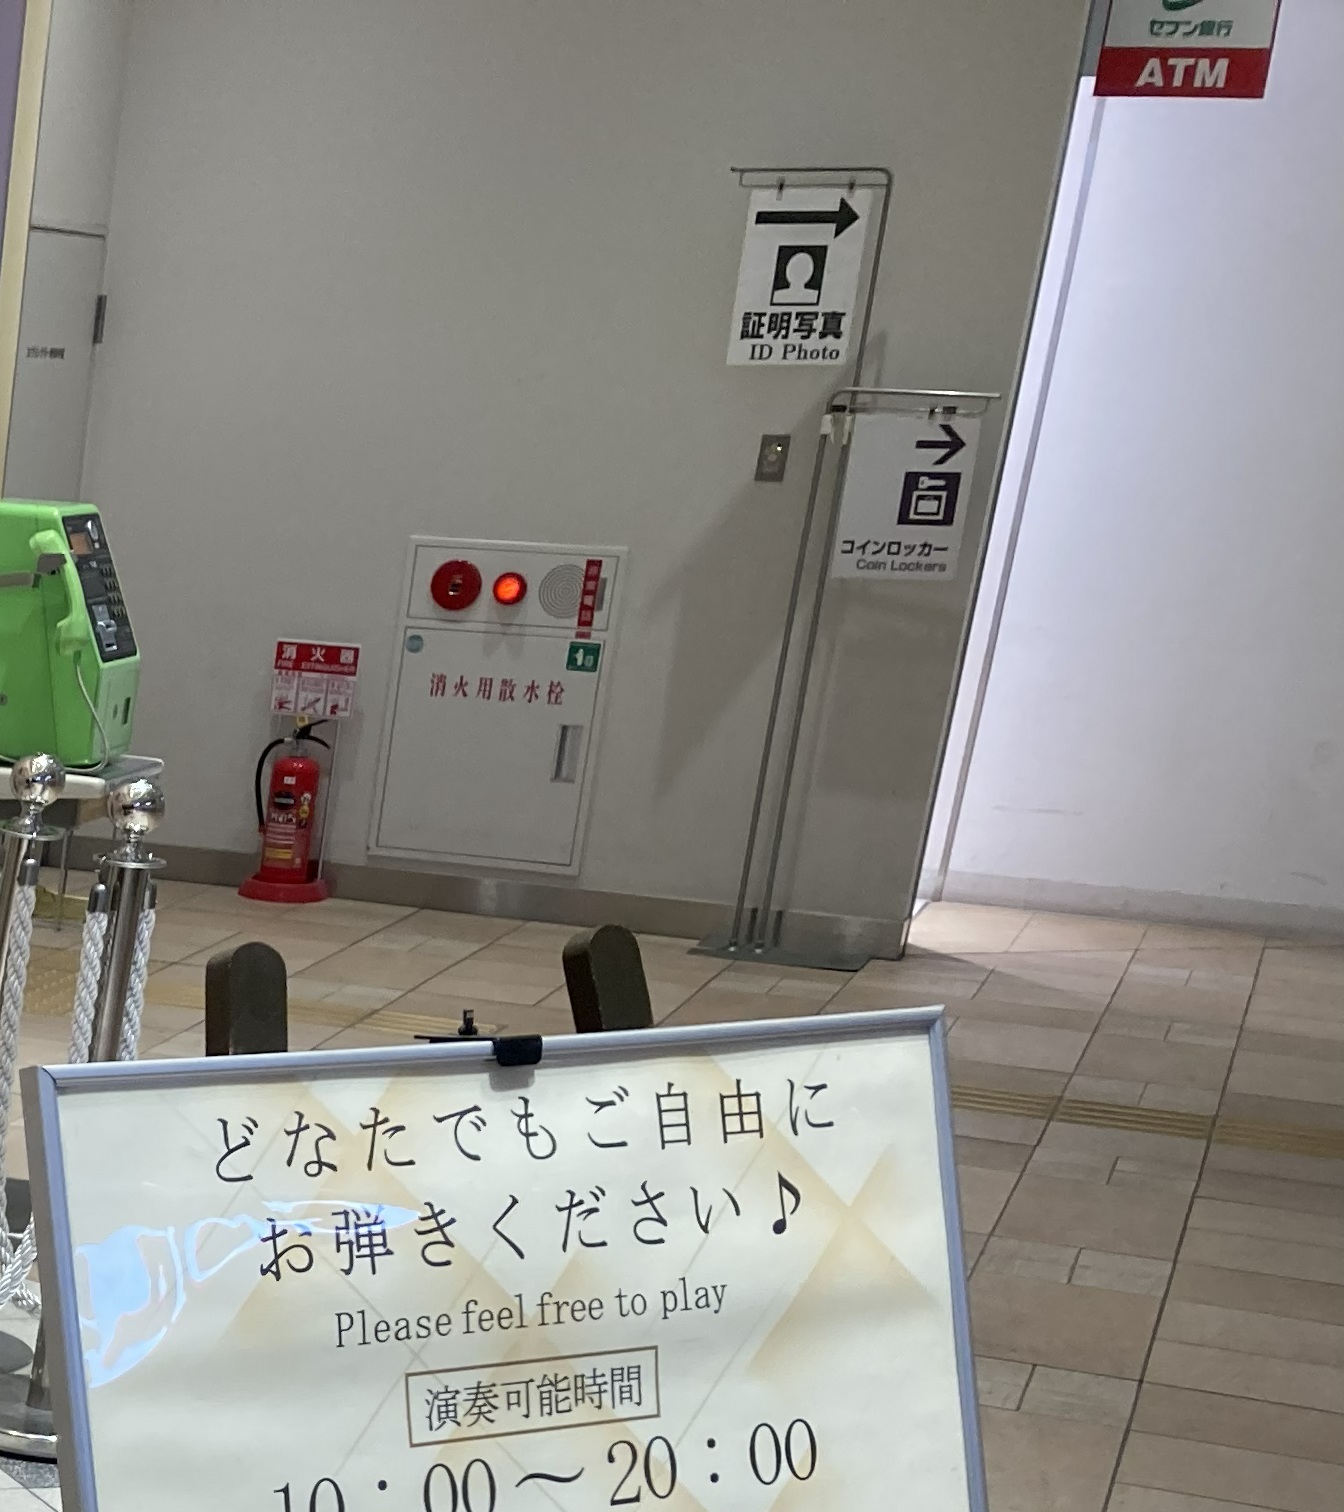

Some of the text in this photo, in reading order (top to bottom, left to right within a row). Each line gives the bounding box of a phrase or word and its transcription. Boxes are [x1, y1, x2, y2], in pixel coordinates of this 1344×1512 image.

[1135, 57, 1230, 88] ATM
[740, 311, 846, 340] 証明写真
[749, 343, 840, 360] ID Photo
[841, 539, 949, 557] コインロッカー
[856, 559, 947, 572] Coin Lockers
[429, 672, 565, 706] 消火用散水栓
[214, 1077, 836, 1183] どなたでもご自由に
[335, 1278, 729, 1348] Please feel free to play
[424, 1366, 644, 1430] 演奏可能時間
